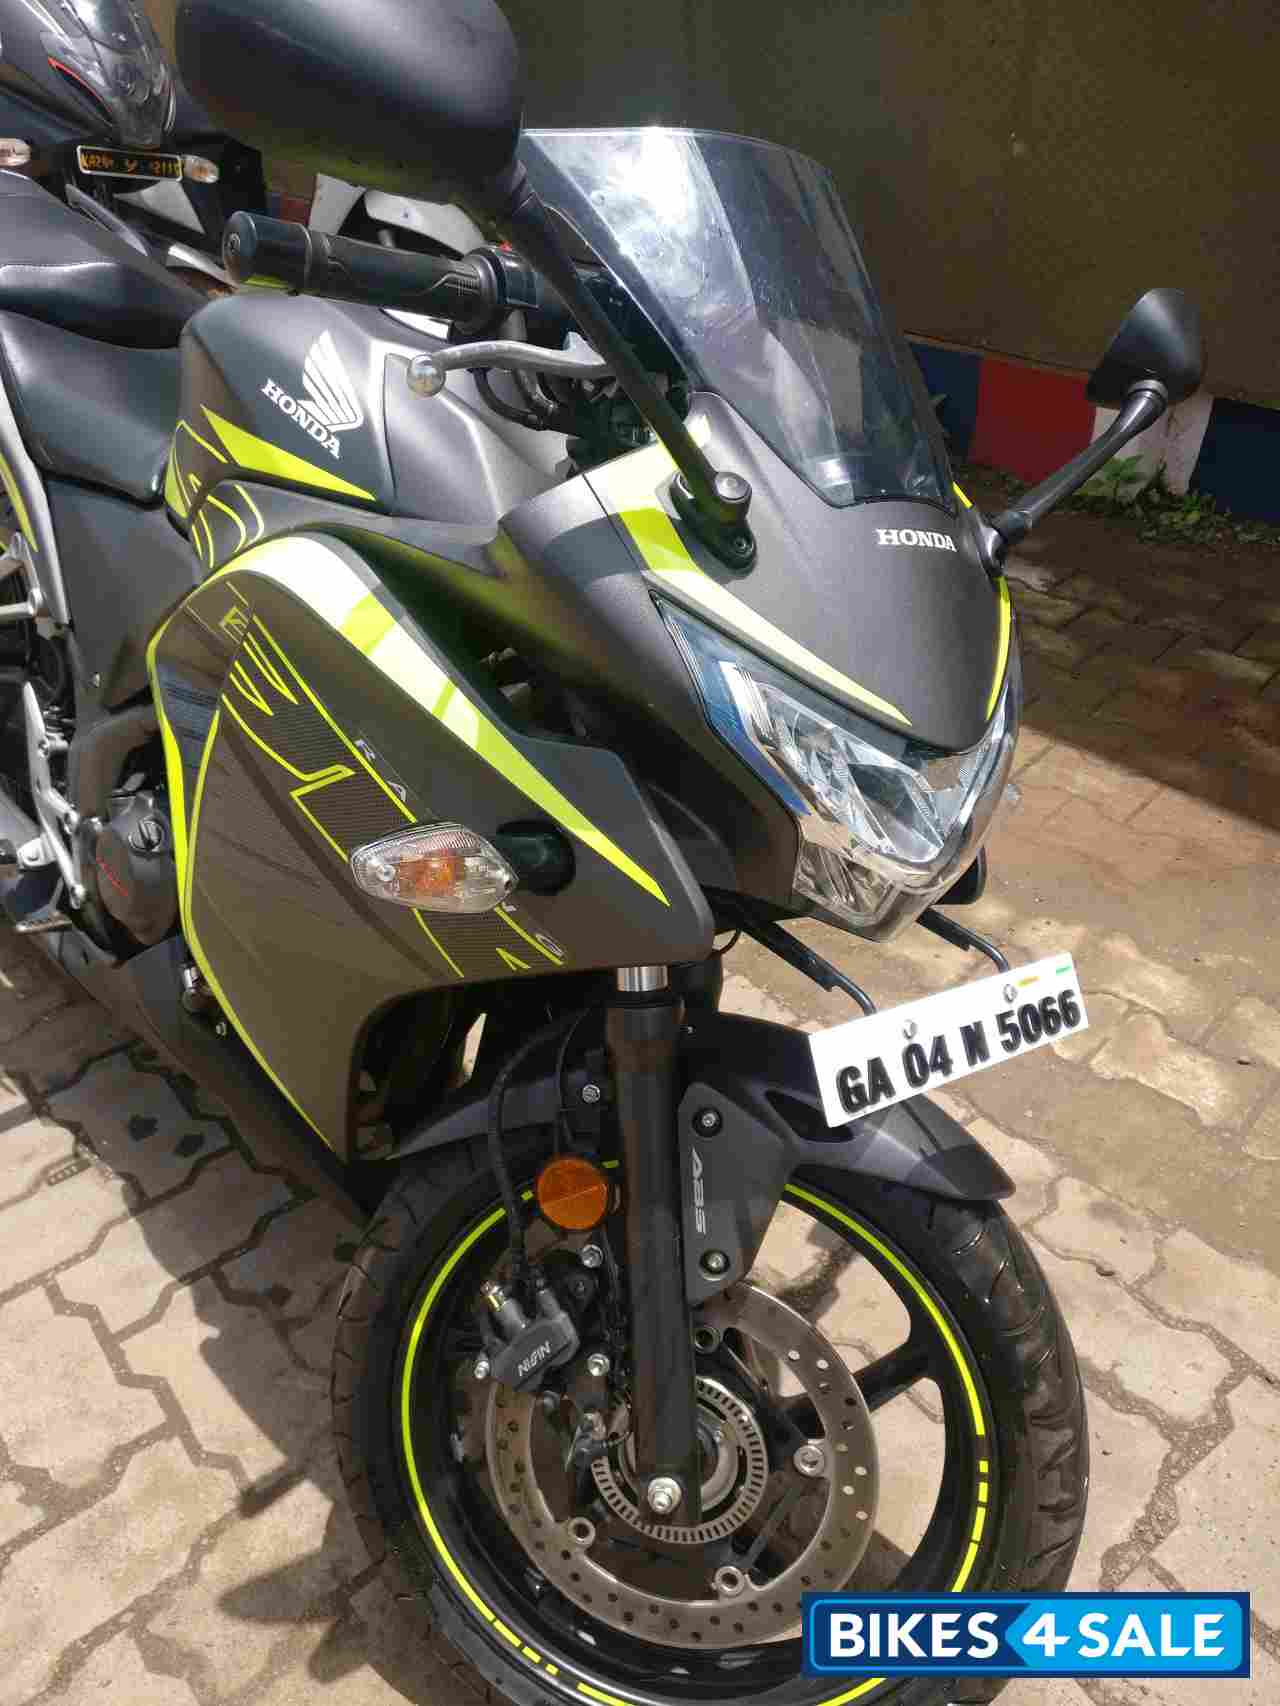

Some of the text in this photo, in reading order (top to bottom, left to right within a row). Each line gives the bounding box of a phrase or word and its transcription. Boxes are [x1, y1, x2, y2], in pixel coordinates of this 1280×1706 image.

[261, 378, 340, 459] HONDA
[875, 528, 957, 552] HONDA
[836, 988, 1081, 1114] GA 04 N 5066
[692, 1146, 706, 1235] ABS
